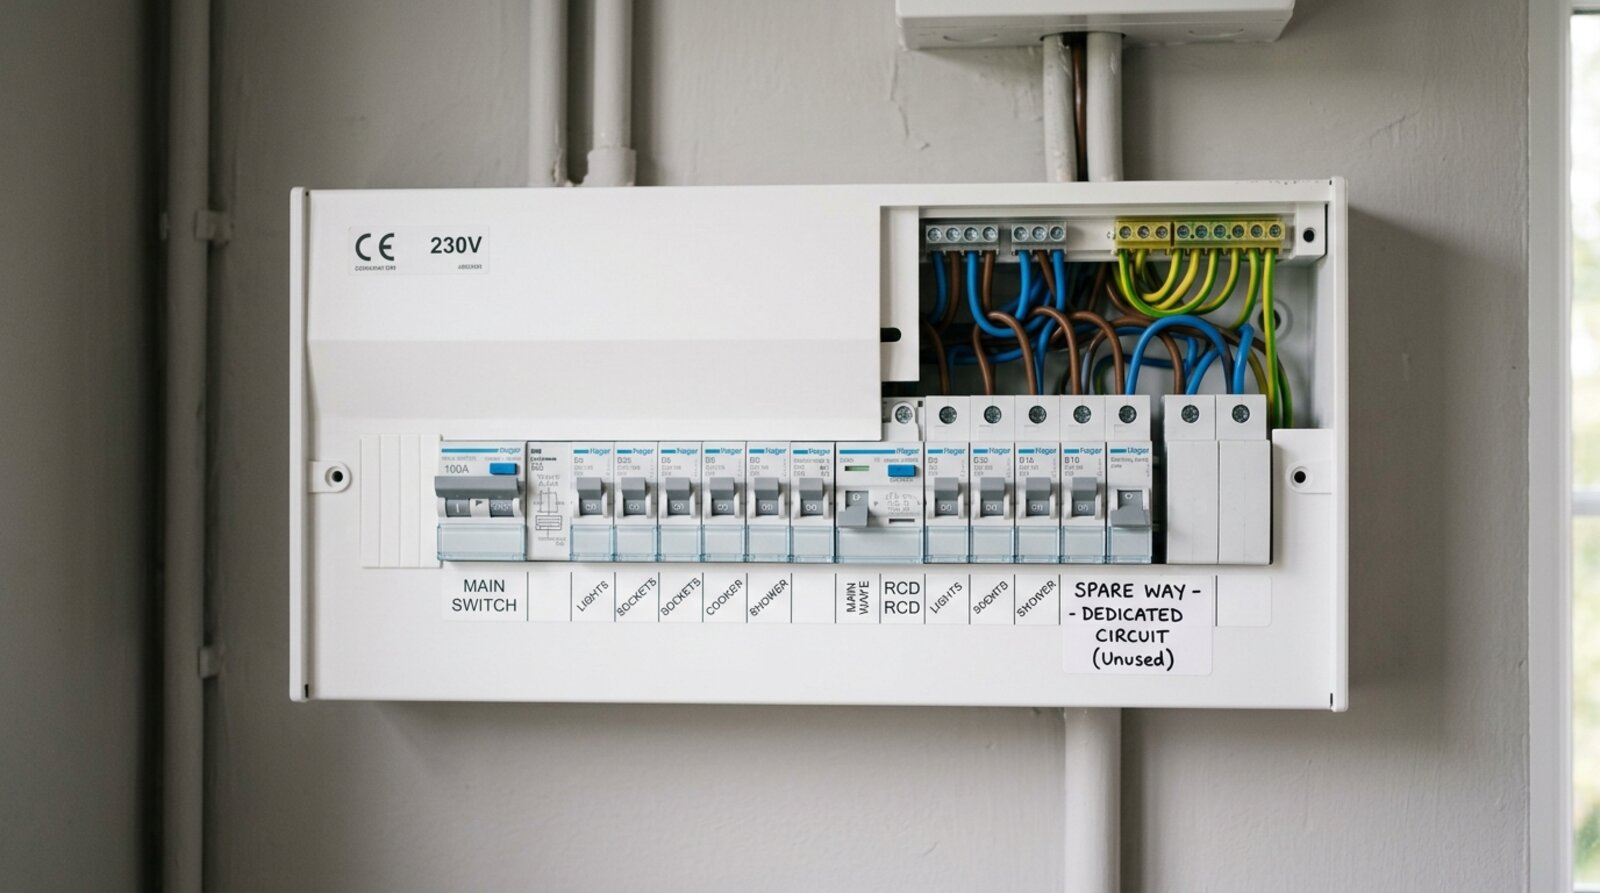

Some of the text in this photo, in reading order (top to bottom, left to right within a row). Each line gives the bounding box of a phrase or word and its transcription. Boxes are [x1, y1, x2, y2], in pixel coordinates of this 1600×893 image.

[430, 236, 482, 254] 230V
[445, 465, 469, 474] 100A
[463, 579, 505, 593] MAIN
[884, 581, 921, 595] RCD
[1074, 581, 1134, 599] SPARE
[1144, 583, 1186, 601] WAY
[576, 580, 609, 612] LIGHTS
[616, 577, 657, 617] SOCKETS
[705, 579, 743, 616] COOKER
[929, 581, 963, 614] LIGHTS
[451, 598, 517, 613] SWITCH
[884, 600, 921, 615] RCD
[1082, 606, 1184, 623] DEDICATED
[1095, 628, 1170, 644] CIRCUIT
[1092, 646, 1174, 672] (Unused)
